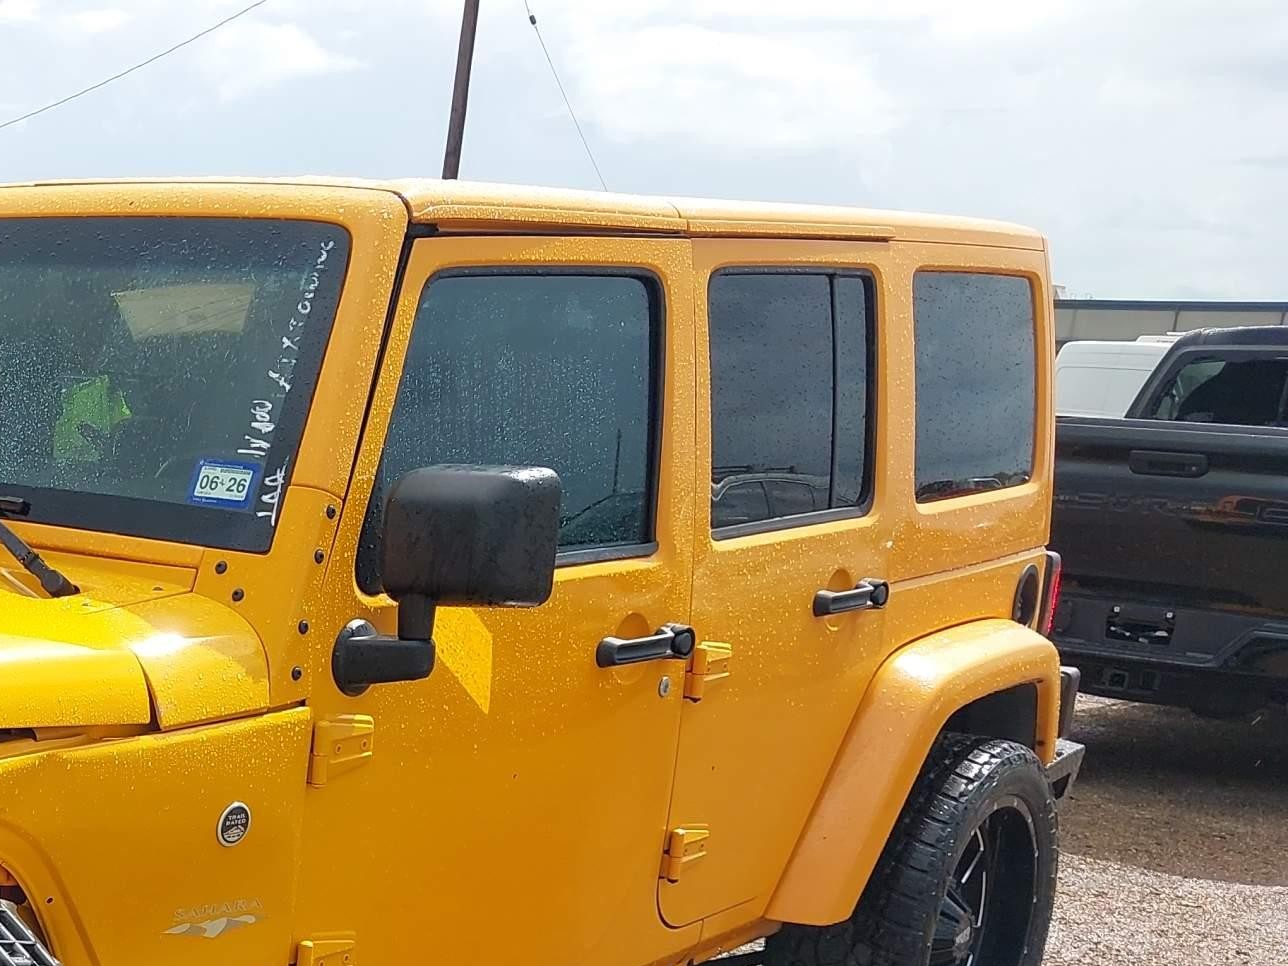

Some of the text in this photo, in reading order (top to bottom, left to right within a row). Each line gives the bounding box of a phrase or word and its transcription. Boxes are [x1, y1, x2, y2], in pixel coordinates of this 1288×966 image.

[199, 474, 247, 494] 06 26
[225, 818, 247, 826] RATED
[174, 896, 264, 920] SAHARA
